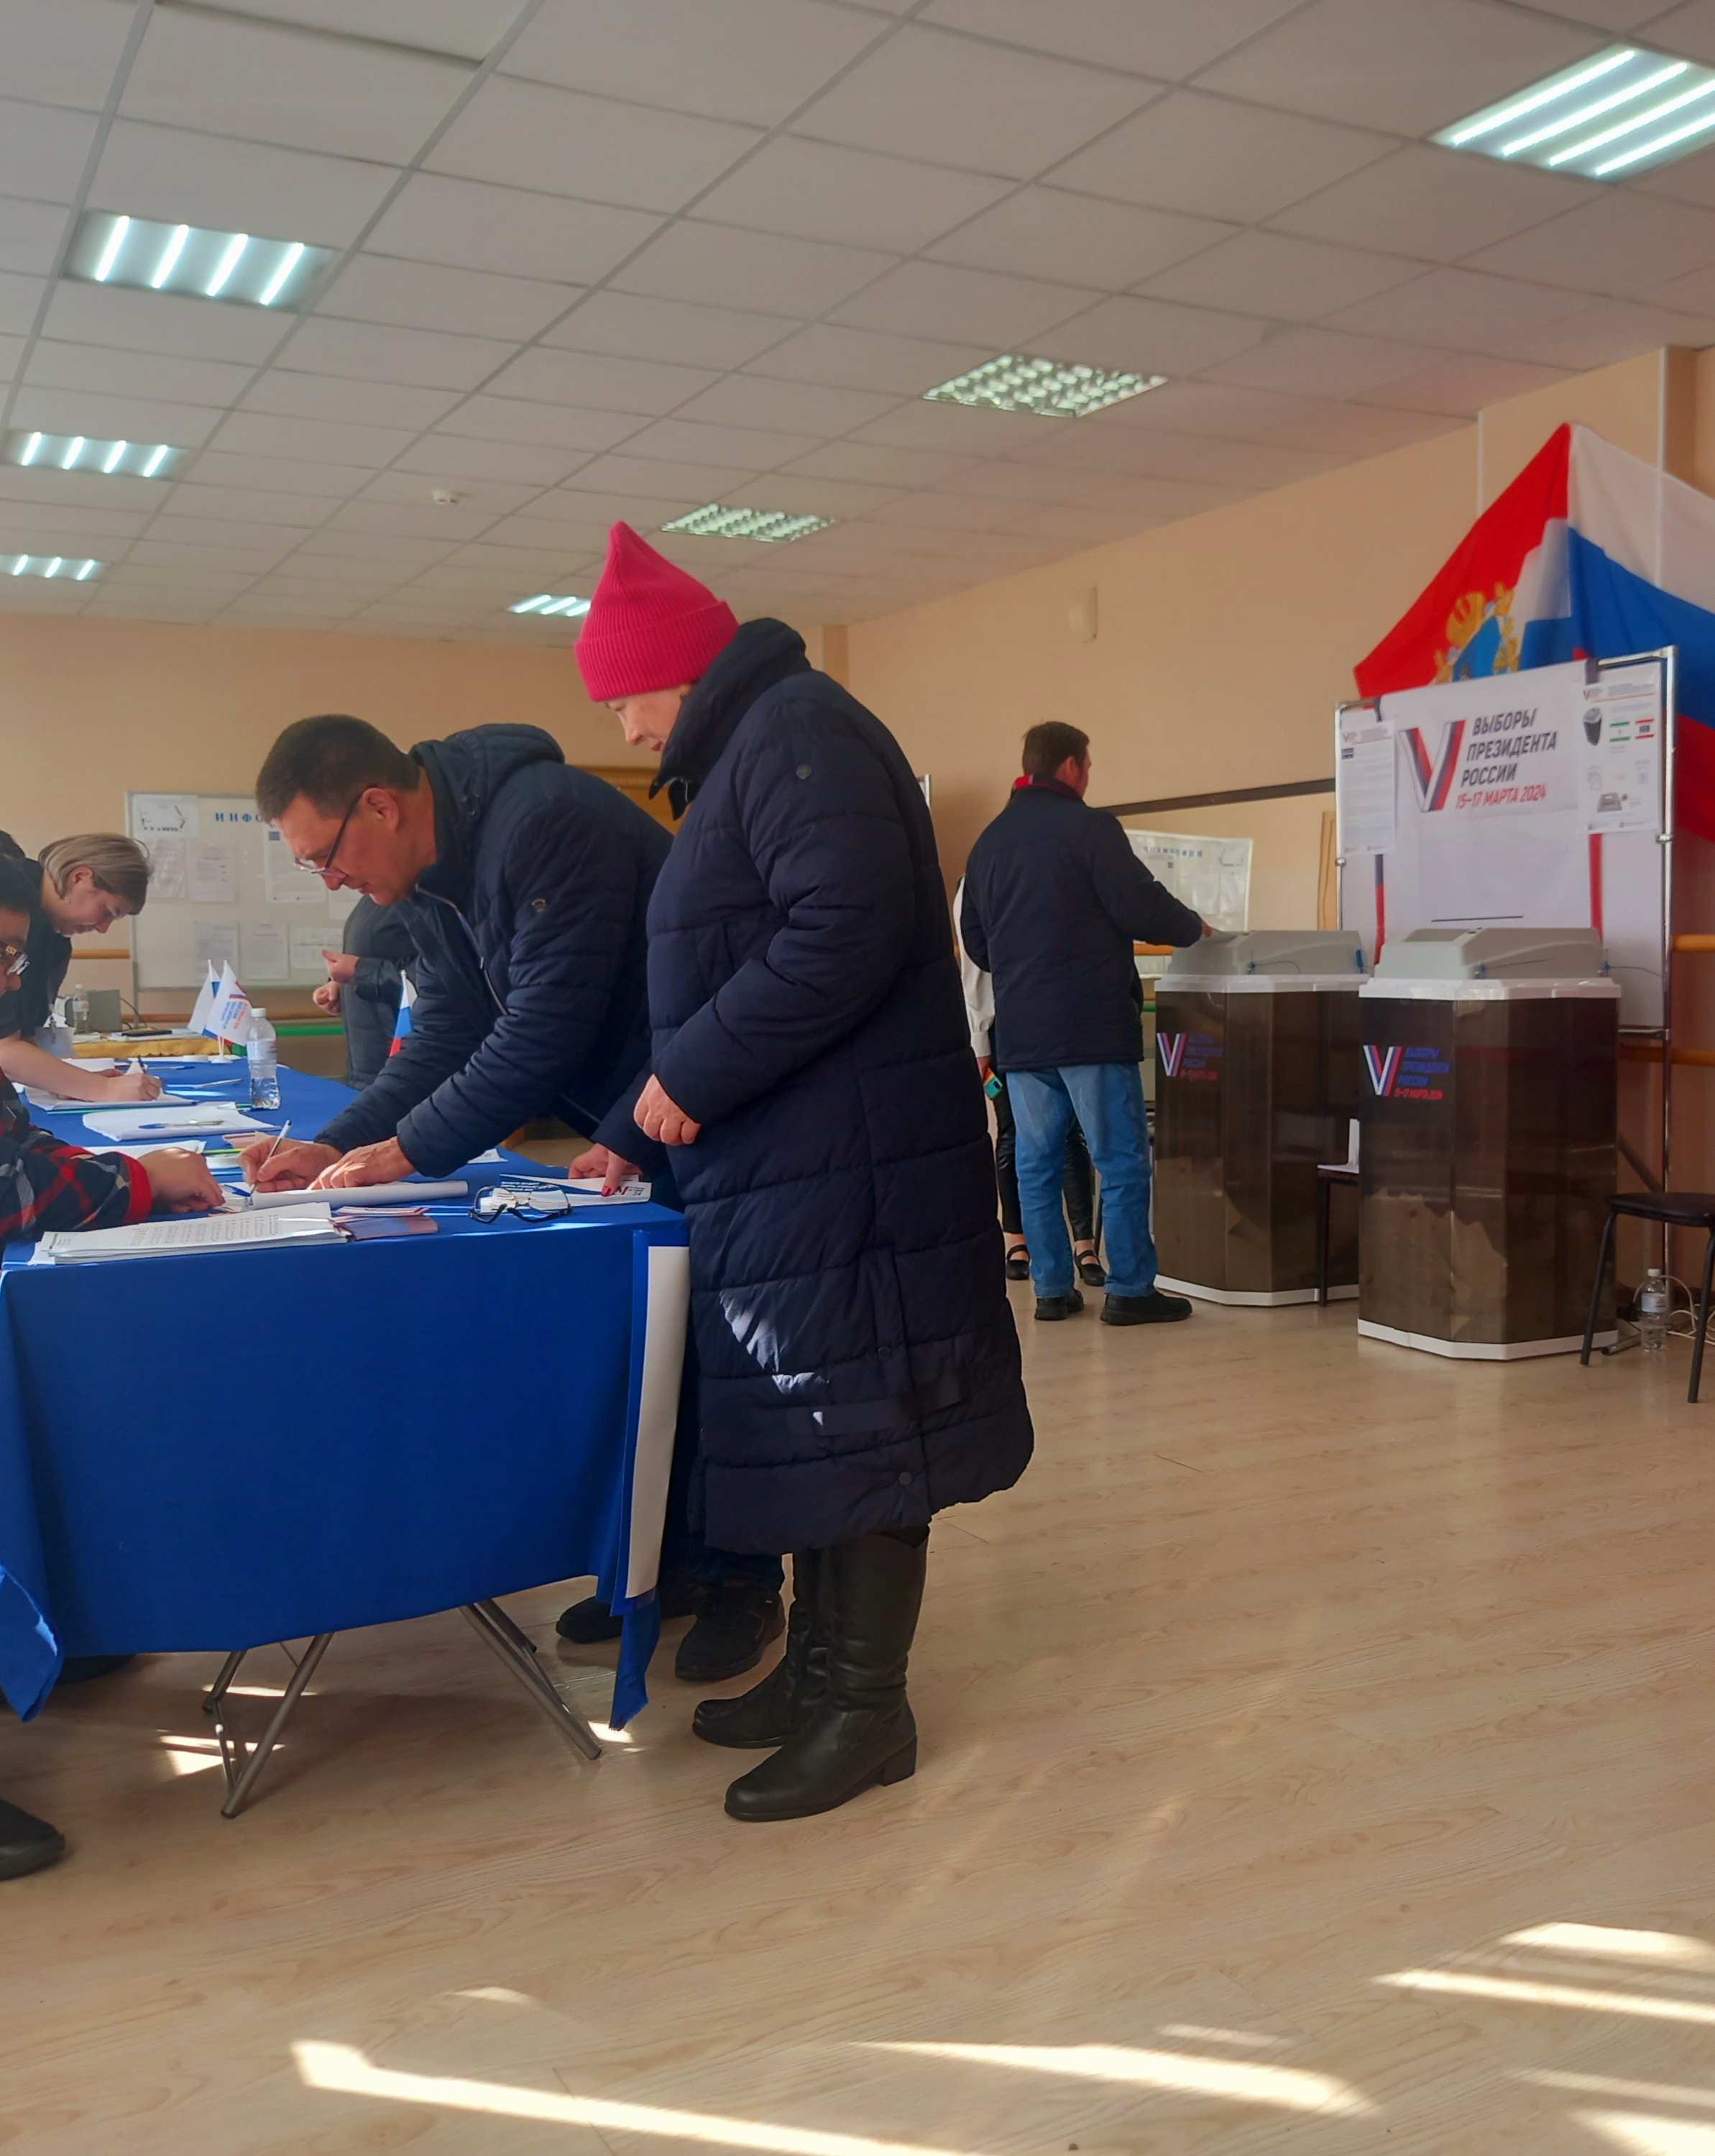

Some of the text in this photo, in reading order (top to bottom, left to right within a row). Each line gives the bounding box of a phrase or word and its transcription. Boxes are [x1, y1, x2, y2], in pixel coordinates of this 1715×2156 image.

[1472, 708, 1537, 736] ВЫБОРЫ
[1466, 731, 1557, 762] ПРЕЗИДЕНТА
[1461, 763, 1517, 788] РОССИИ
[1483, 787, 1519, 806] МАРТА
[1520, 784, 1547, 802] 2024
[215, 813, 262, 823] ИНФО
